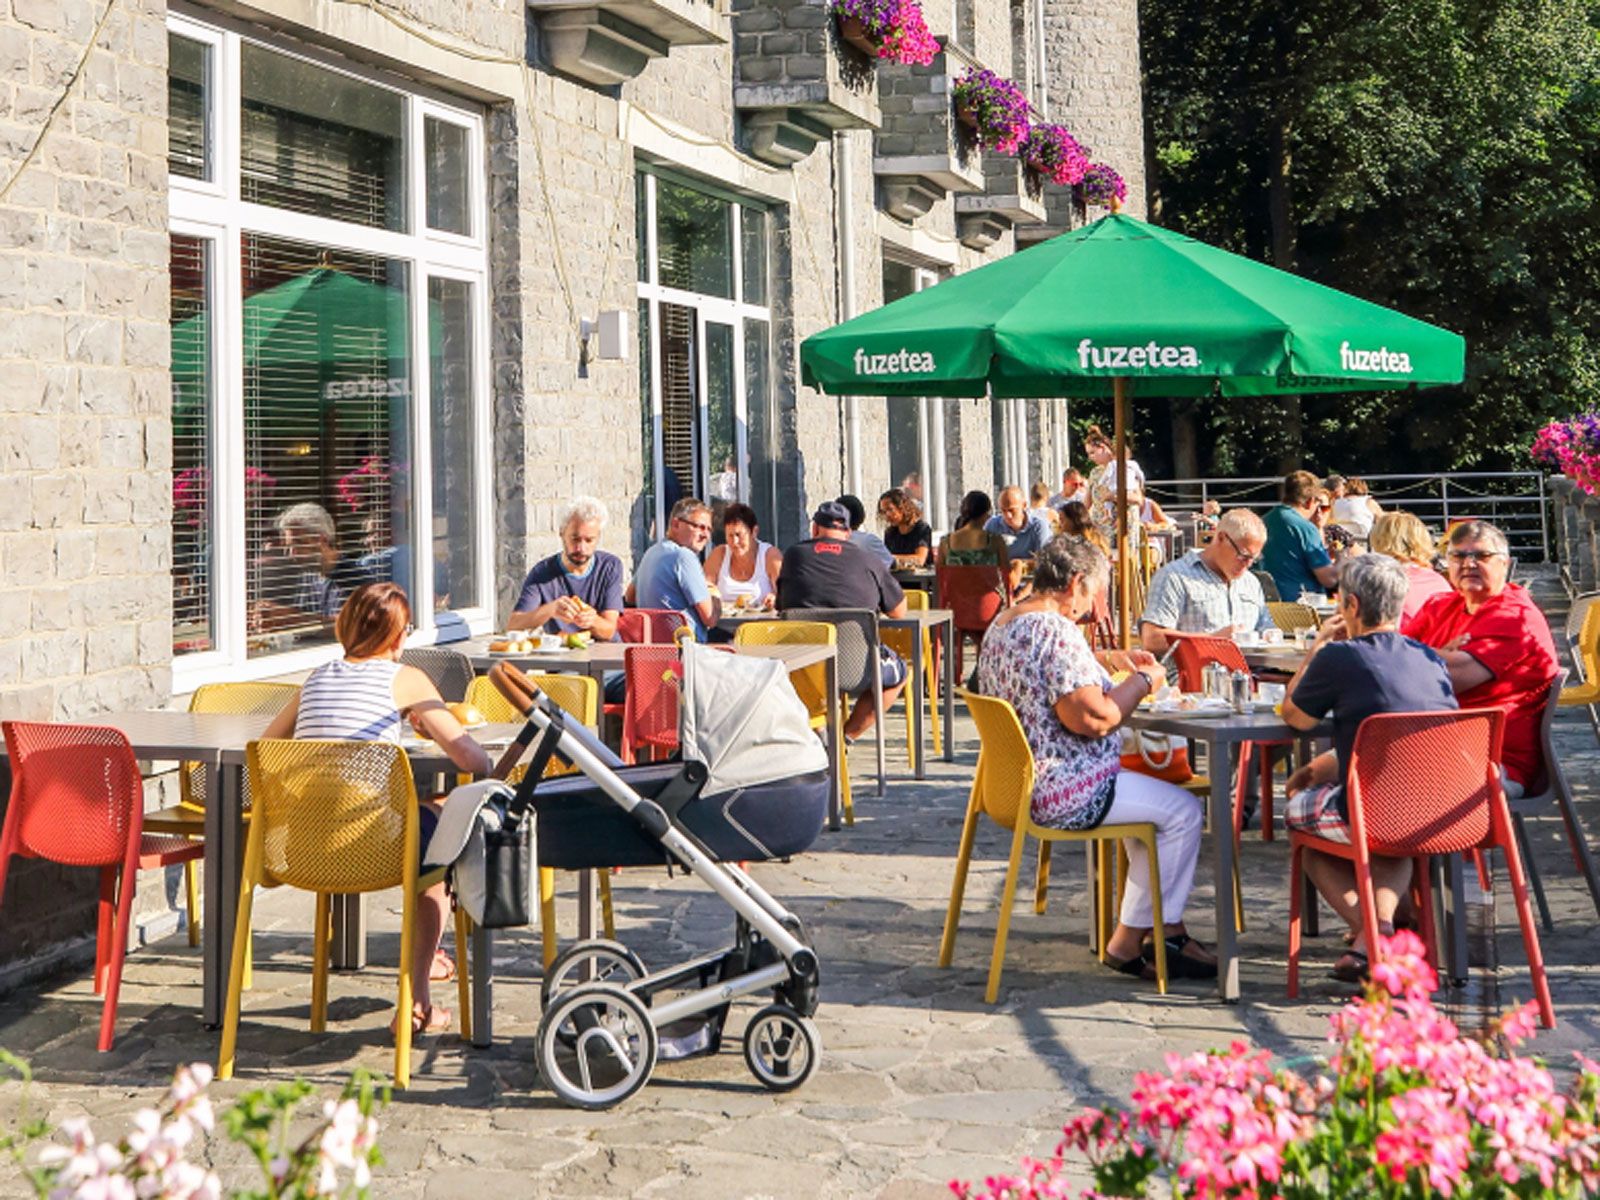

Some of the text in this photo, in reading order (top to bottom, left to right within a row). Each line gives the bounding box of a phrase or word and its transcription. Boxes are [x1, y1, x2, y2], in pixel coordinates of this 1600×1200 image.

[853, 347, 935, 375] fuzetea
[1077, 338, 1199, 369] fuzetea
[1339, 340, 1412, 373] fuzetea
